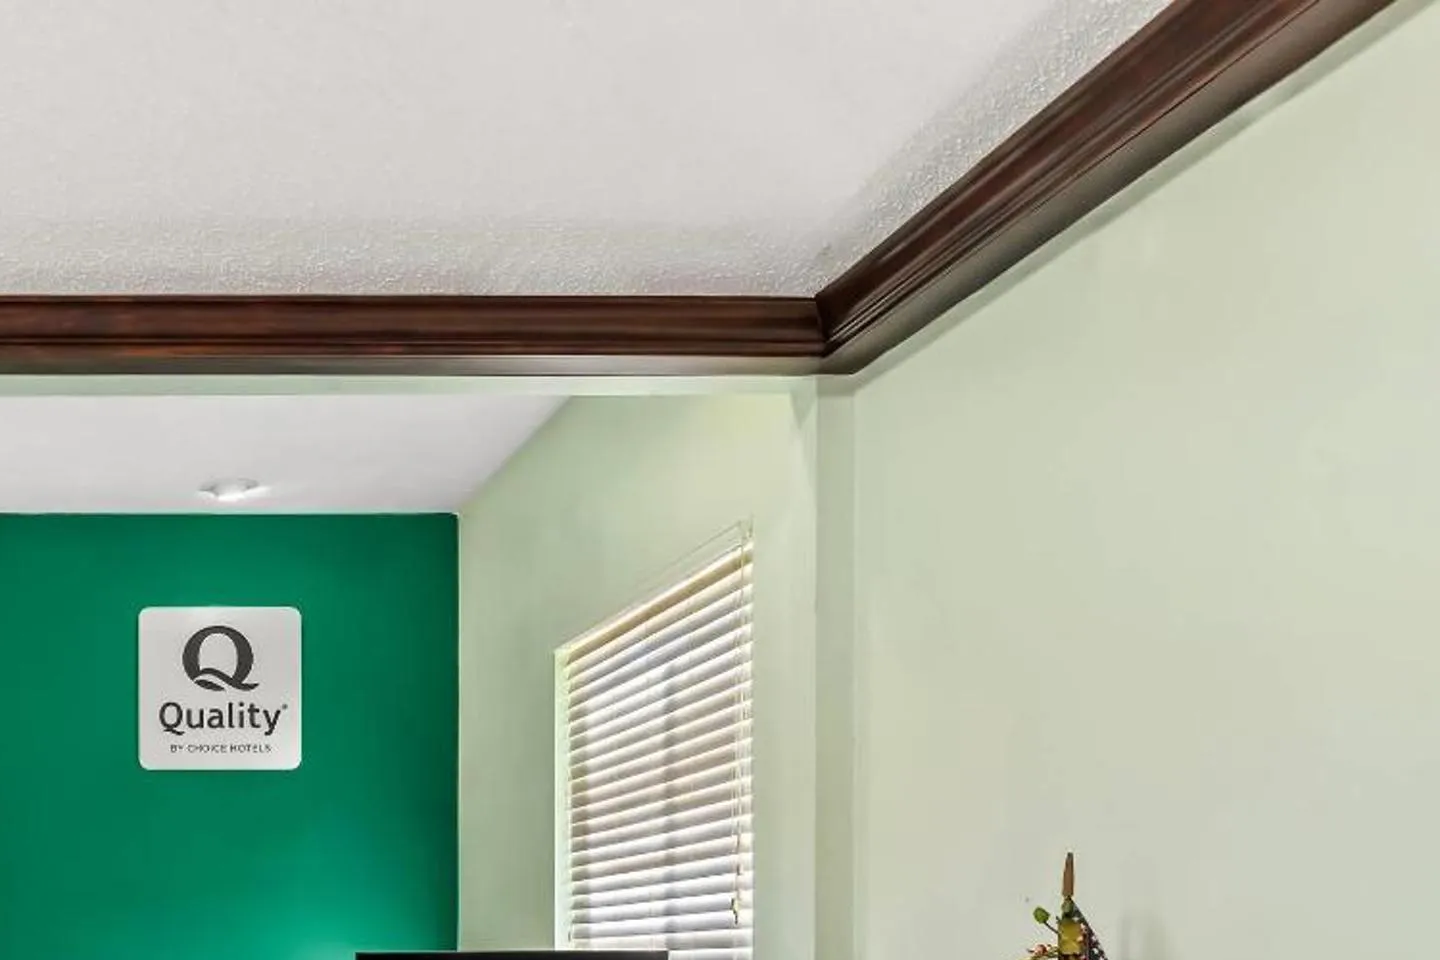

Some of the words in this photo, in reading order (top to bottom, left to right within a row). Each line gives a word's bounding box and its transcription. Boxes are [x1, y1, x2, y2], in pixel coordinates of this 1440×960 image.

[182, 625, 260, 692] Q
[159, 701, 282, 737] Quality
[169, 743, 184, 754] BY
[187, 743, 227, 754] CHOICE
[229, 743, 273, 754] HOTELS
